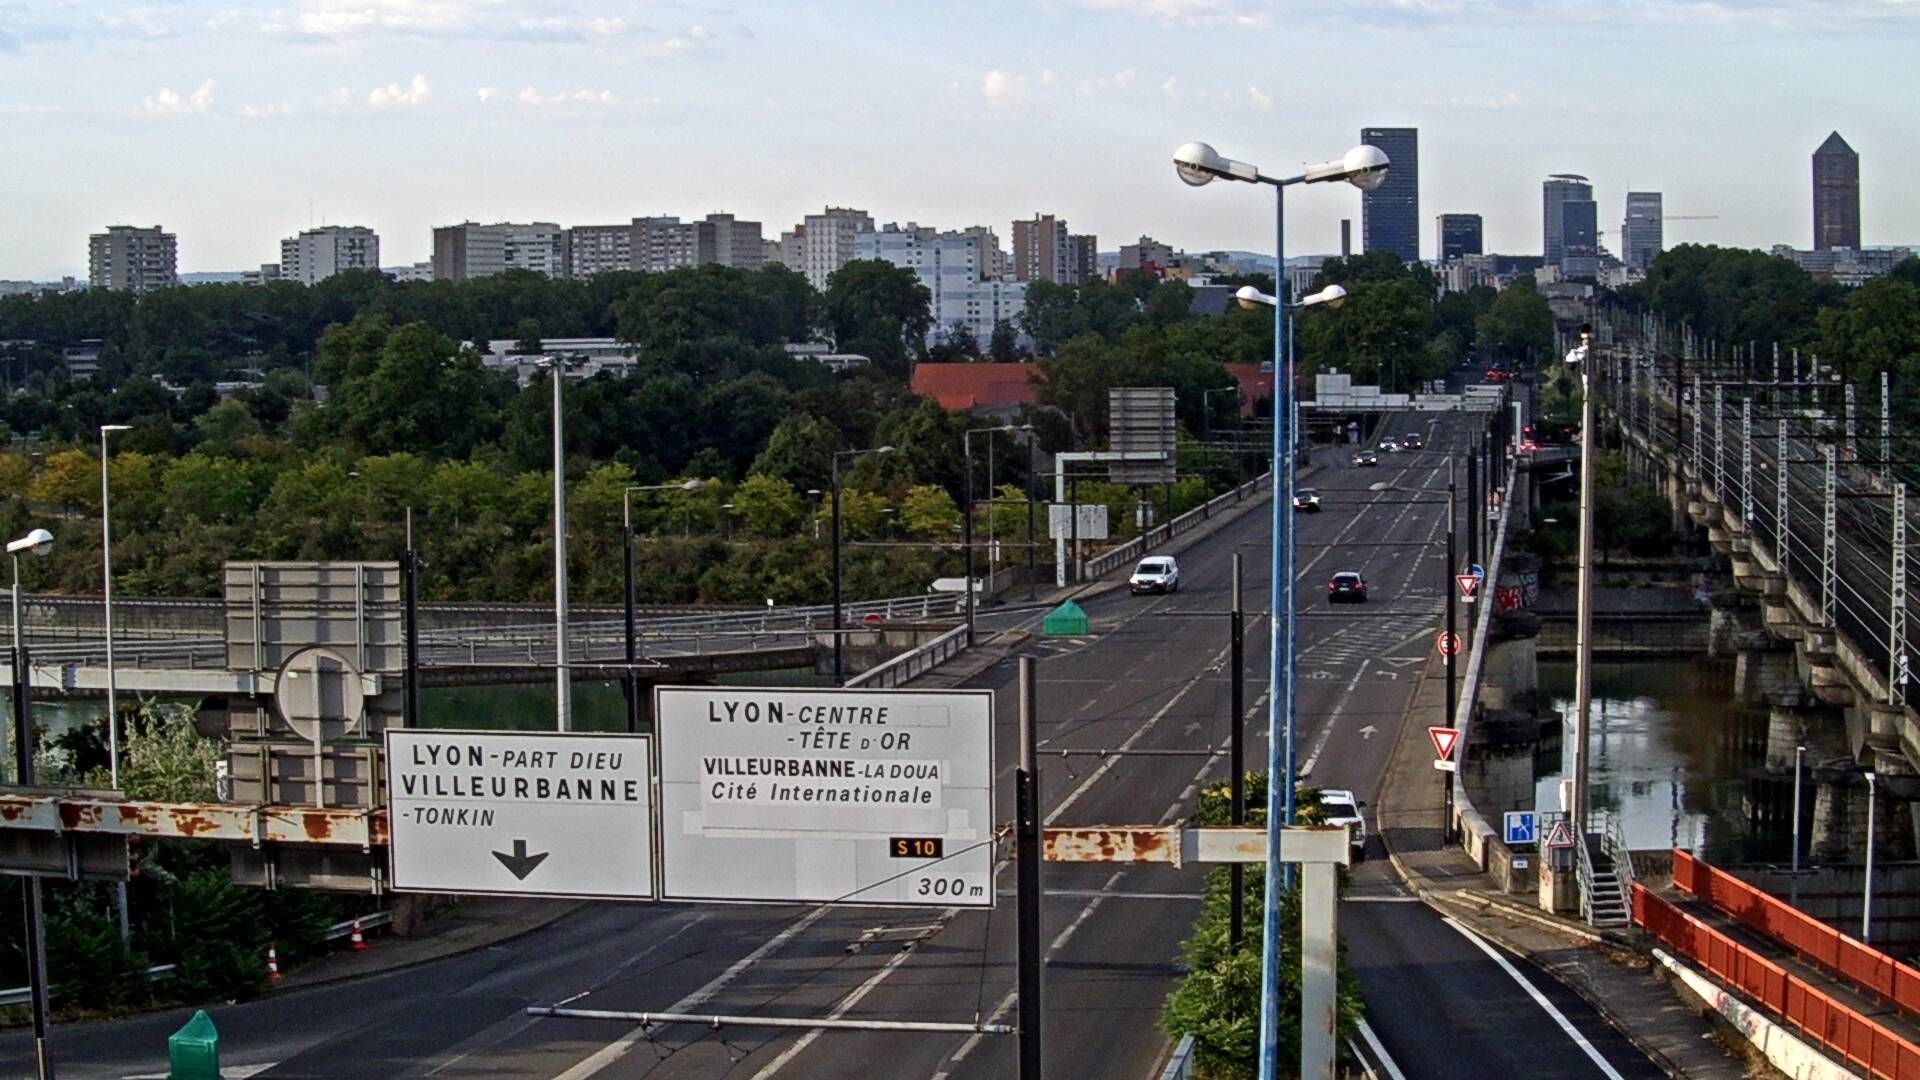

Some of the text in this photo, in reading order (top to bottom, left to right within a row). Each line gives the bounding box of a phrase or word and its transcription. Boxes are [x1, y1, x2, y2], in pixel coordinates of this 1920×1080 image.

[569, 752, 623, 770] DIEU
[401, 774, 639, 801] VILLEURBANNE
[711, 781, 932, 803] Cité Internationale
